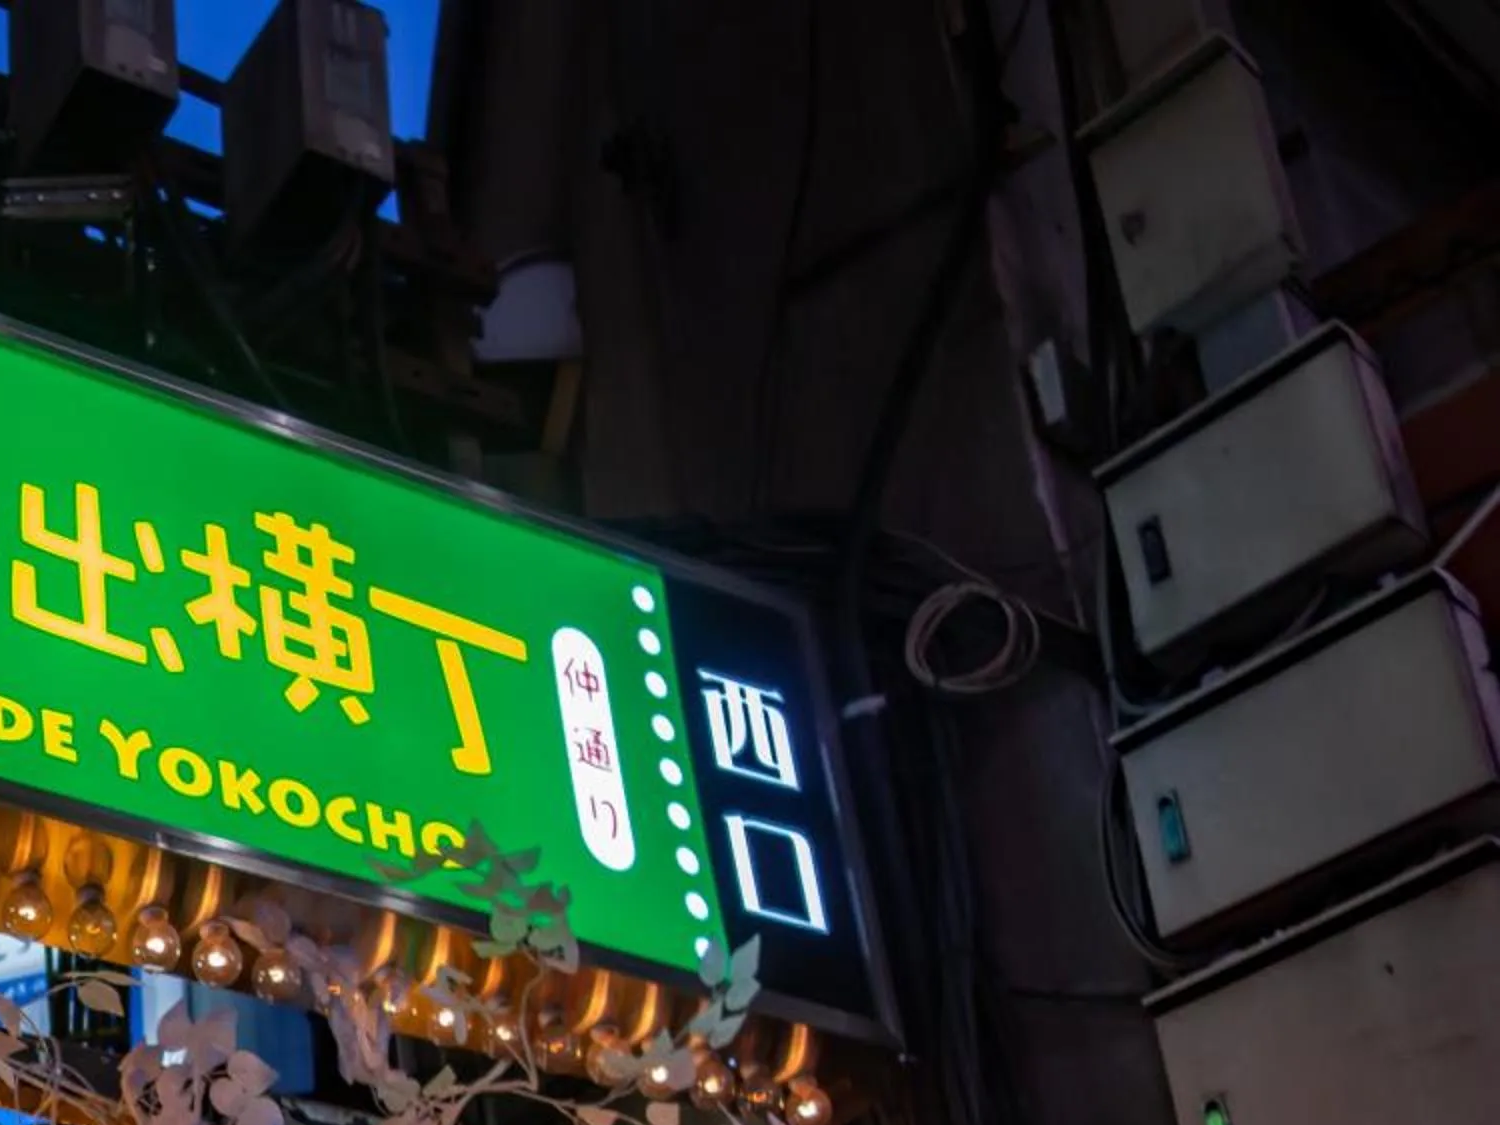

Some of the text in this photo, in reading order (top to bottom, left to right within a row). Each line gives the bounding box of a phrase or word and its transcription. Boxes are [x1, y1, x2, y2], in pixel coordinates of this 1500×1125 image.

[100, 719, 465, 868] YOKOCHO
[563, 658, 619, 842] 仲通り
[698, 668, 829, 934] 西口
